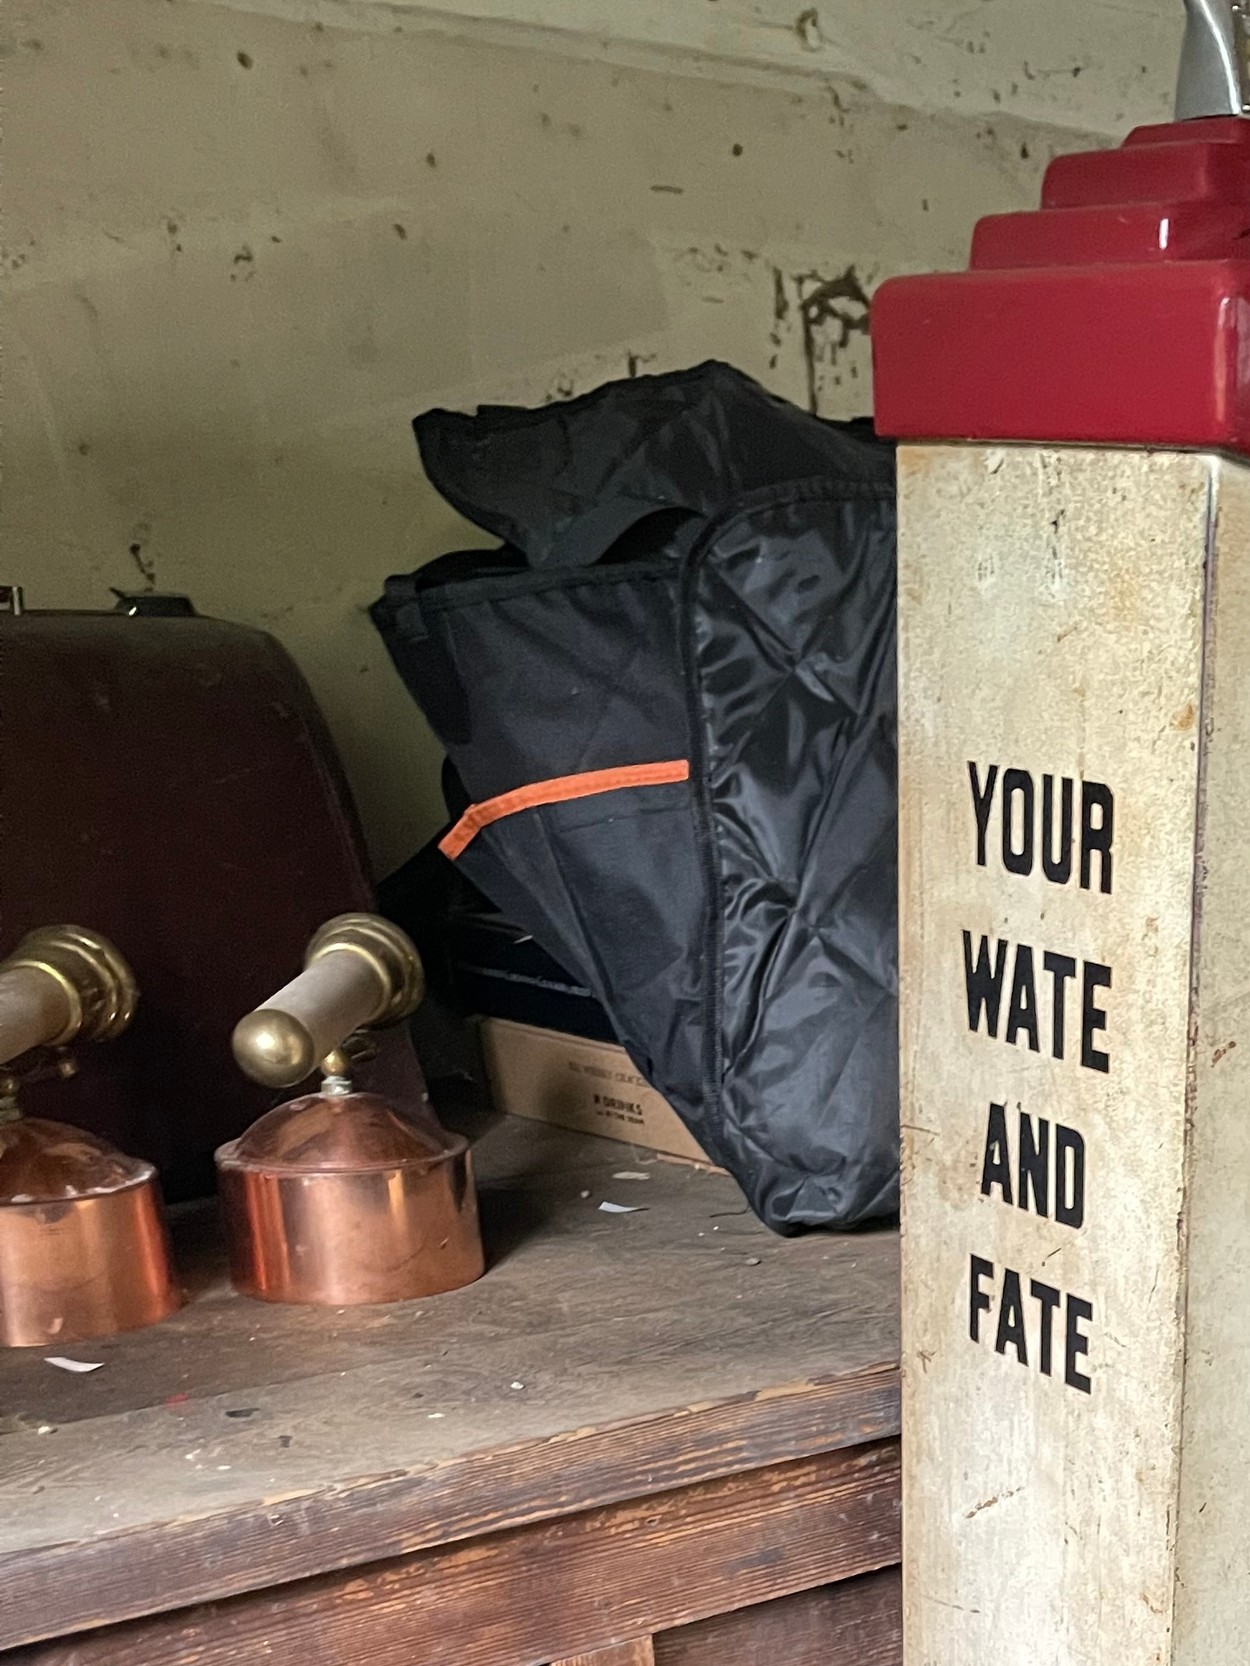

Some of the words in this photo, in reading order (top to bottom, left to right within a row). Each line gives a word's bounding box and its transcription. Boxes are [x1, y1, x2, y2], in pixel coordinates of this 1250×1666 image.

[967, 761, 1113, 895] YOUR
[962, 929, 1111, 1074] WATE
[981, 1102, 1085, 1230] AND
[969, 1253, 1093, 1395] FATE
